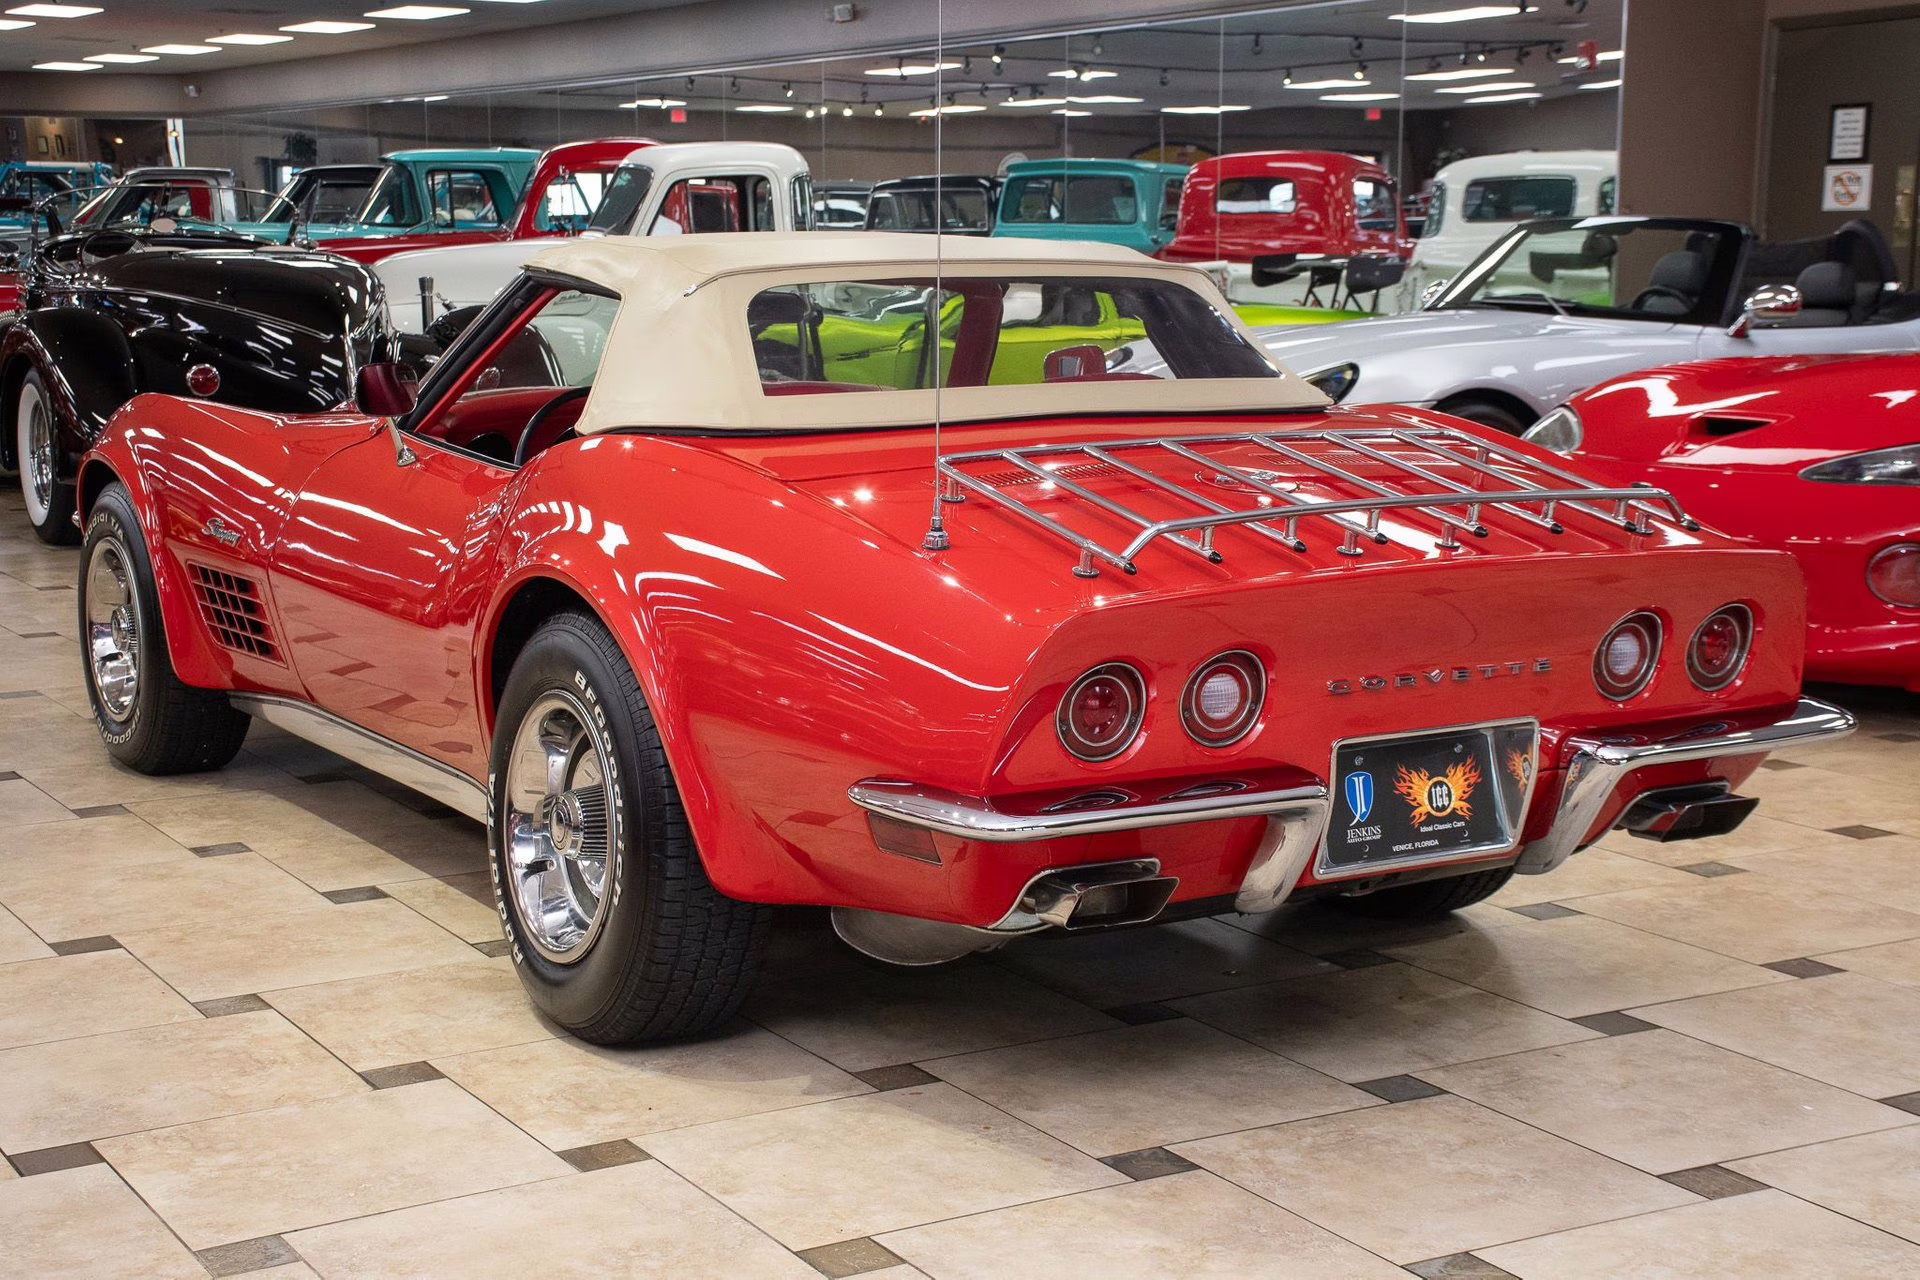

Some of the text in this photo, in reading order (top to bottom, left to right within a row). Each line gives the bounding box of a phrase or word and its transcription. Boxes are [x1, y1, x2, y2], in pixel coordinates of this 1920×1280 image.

[1326, 657, 1553, 695] CORVETTE
[573, 670, 625, 907] BFGoodrich
[1346, 825, 1382, 840] JENKINS
[1419, 820, 1466, 833] Ideal Classic Cars
[1346, 834, 1382, 844] AUTO GROUP
[1392, 839, 1440, 853] VENICE, FLORIDA
